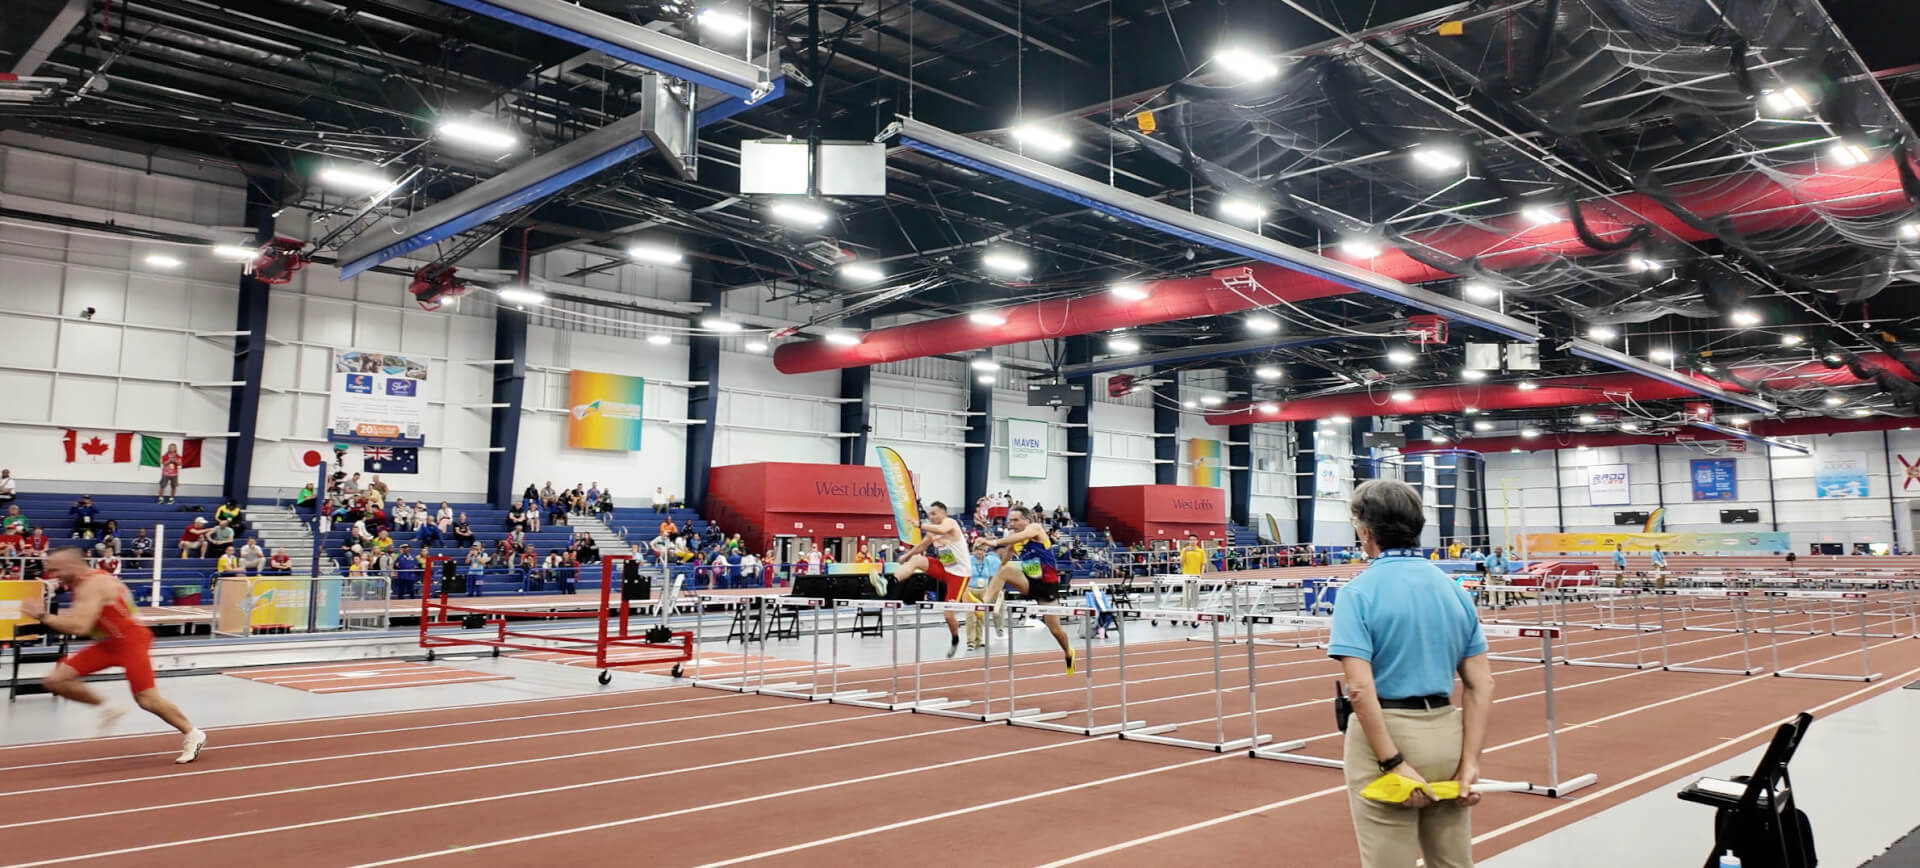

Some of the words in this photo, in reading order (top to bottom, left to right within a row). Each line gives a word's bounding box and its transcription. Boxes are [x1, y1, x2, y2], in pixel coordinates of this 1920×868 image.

[1012, 438, 1039, 448] MAVEN
[815, 480, 850, 497] West
[853, 481, 888, 502] Lobby
[1172, 498, 1193, 510] West
[1194, 498, 1215, 512] Lobby
